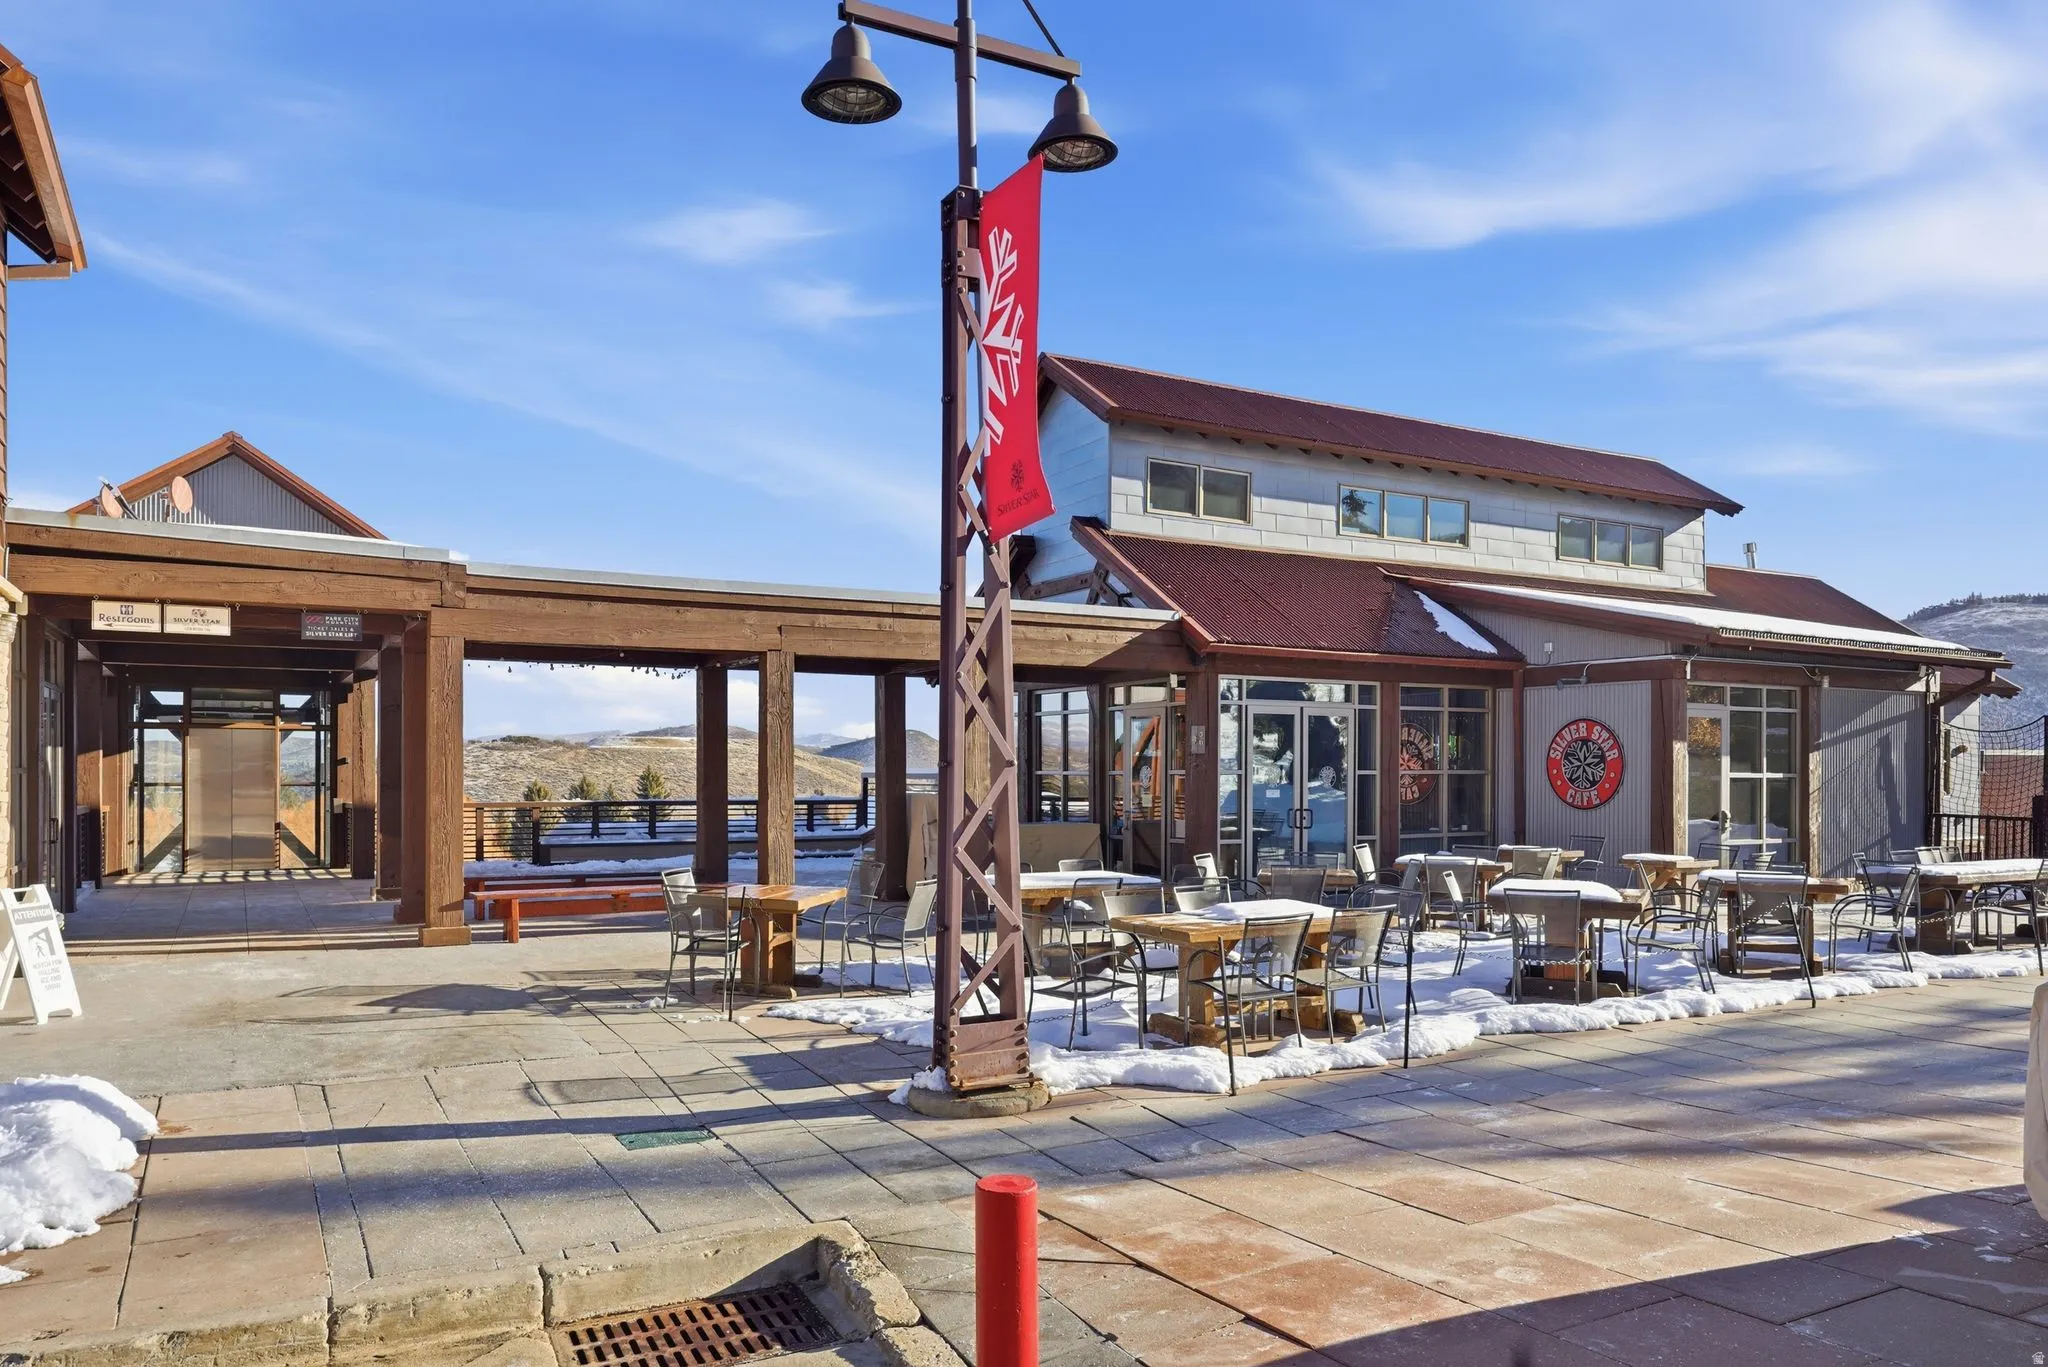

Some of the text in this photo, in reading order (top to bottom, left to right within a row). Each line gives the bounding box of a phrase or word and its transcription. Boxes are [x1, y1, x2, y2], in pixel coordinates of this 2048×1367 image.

[1549, 722, 1619, 761] SILVER STAR
[1566, 788, 1601, 806] CAFE
